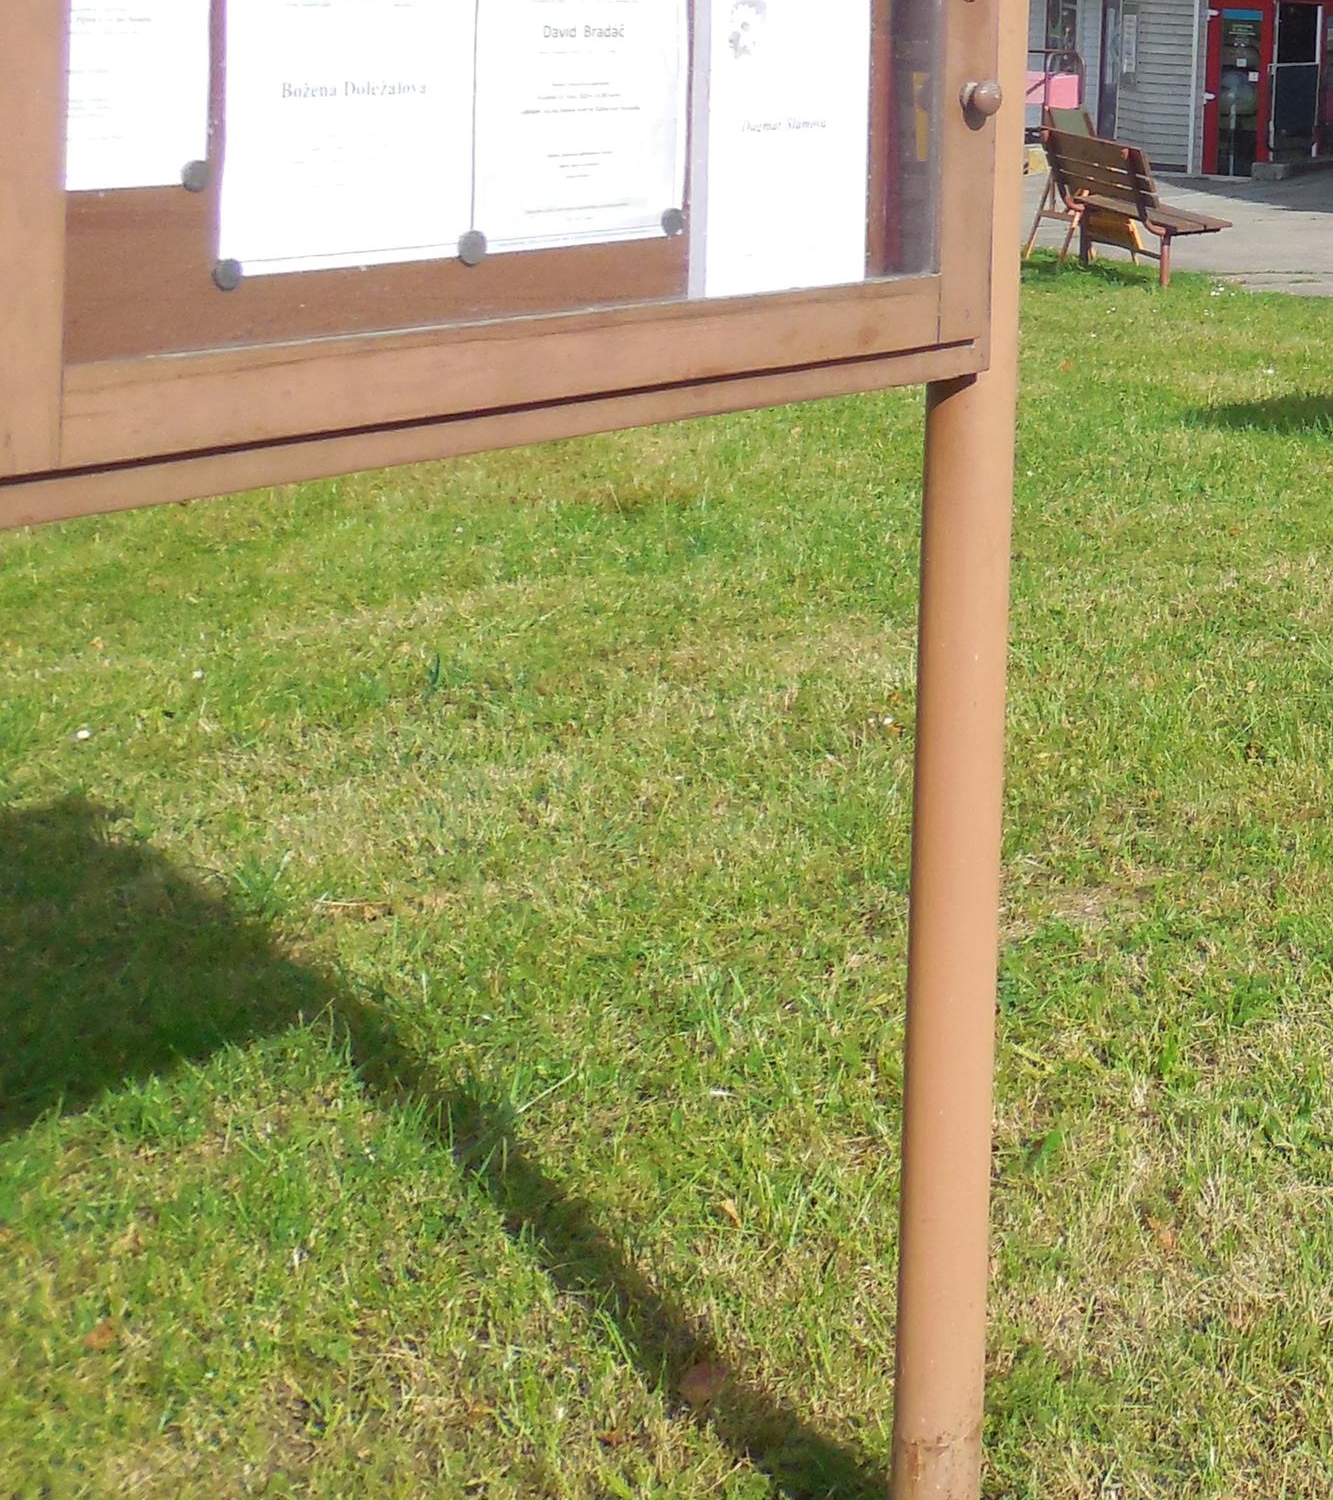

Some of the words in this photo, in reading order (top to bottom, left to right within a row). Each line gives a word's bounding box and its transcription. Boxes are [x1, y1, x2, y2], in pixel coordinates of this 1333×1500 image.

[543, 25, 577, 39] David
[583, 23, 626, 39] Bradáč
[280, 82, 338, 100] Božena
